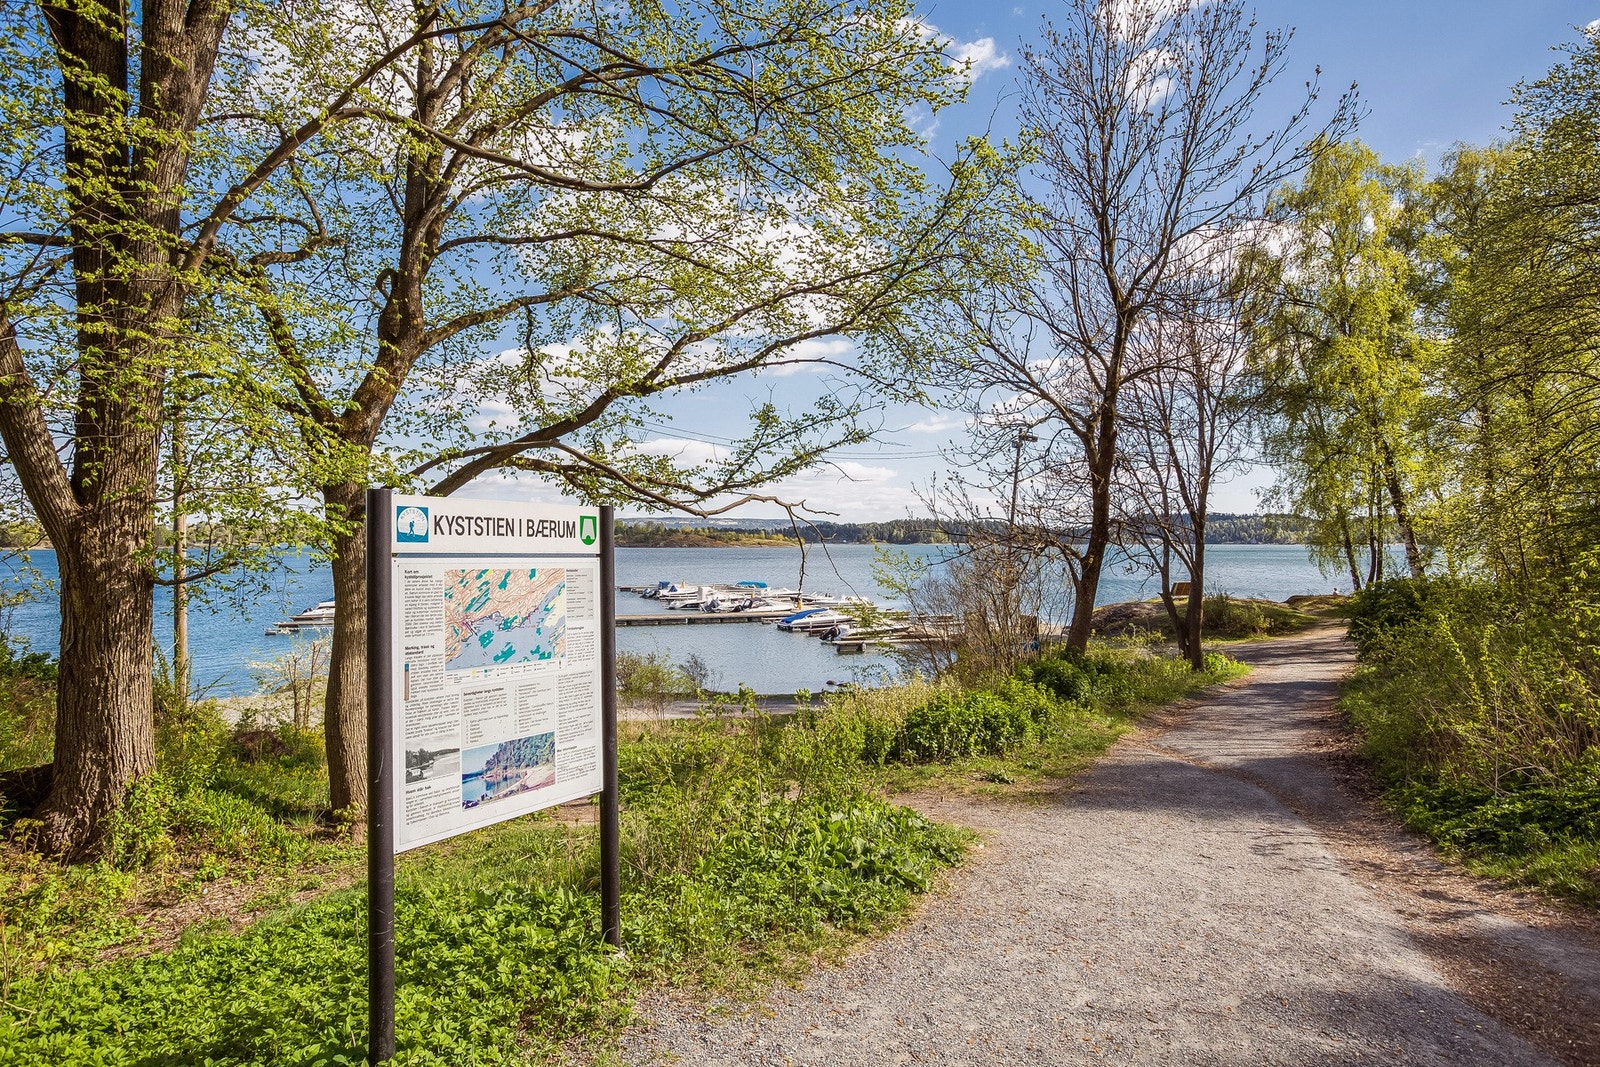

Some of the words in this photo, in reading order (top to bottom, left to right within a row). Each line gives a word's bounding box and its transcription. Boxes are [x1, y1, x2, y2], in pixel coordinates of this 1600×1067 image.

[433, 515, 515, 537] KYSTSTIEN
[519, 517, 522, 537] I
[527, 518, 576, 538] BÆRUM
